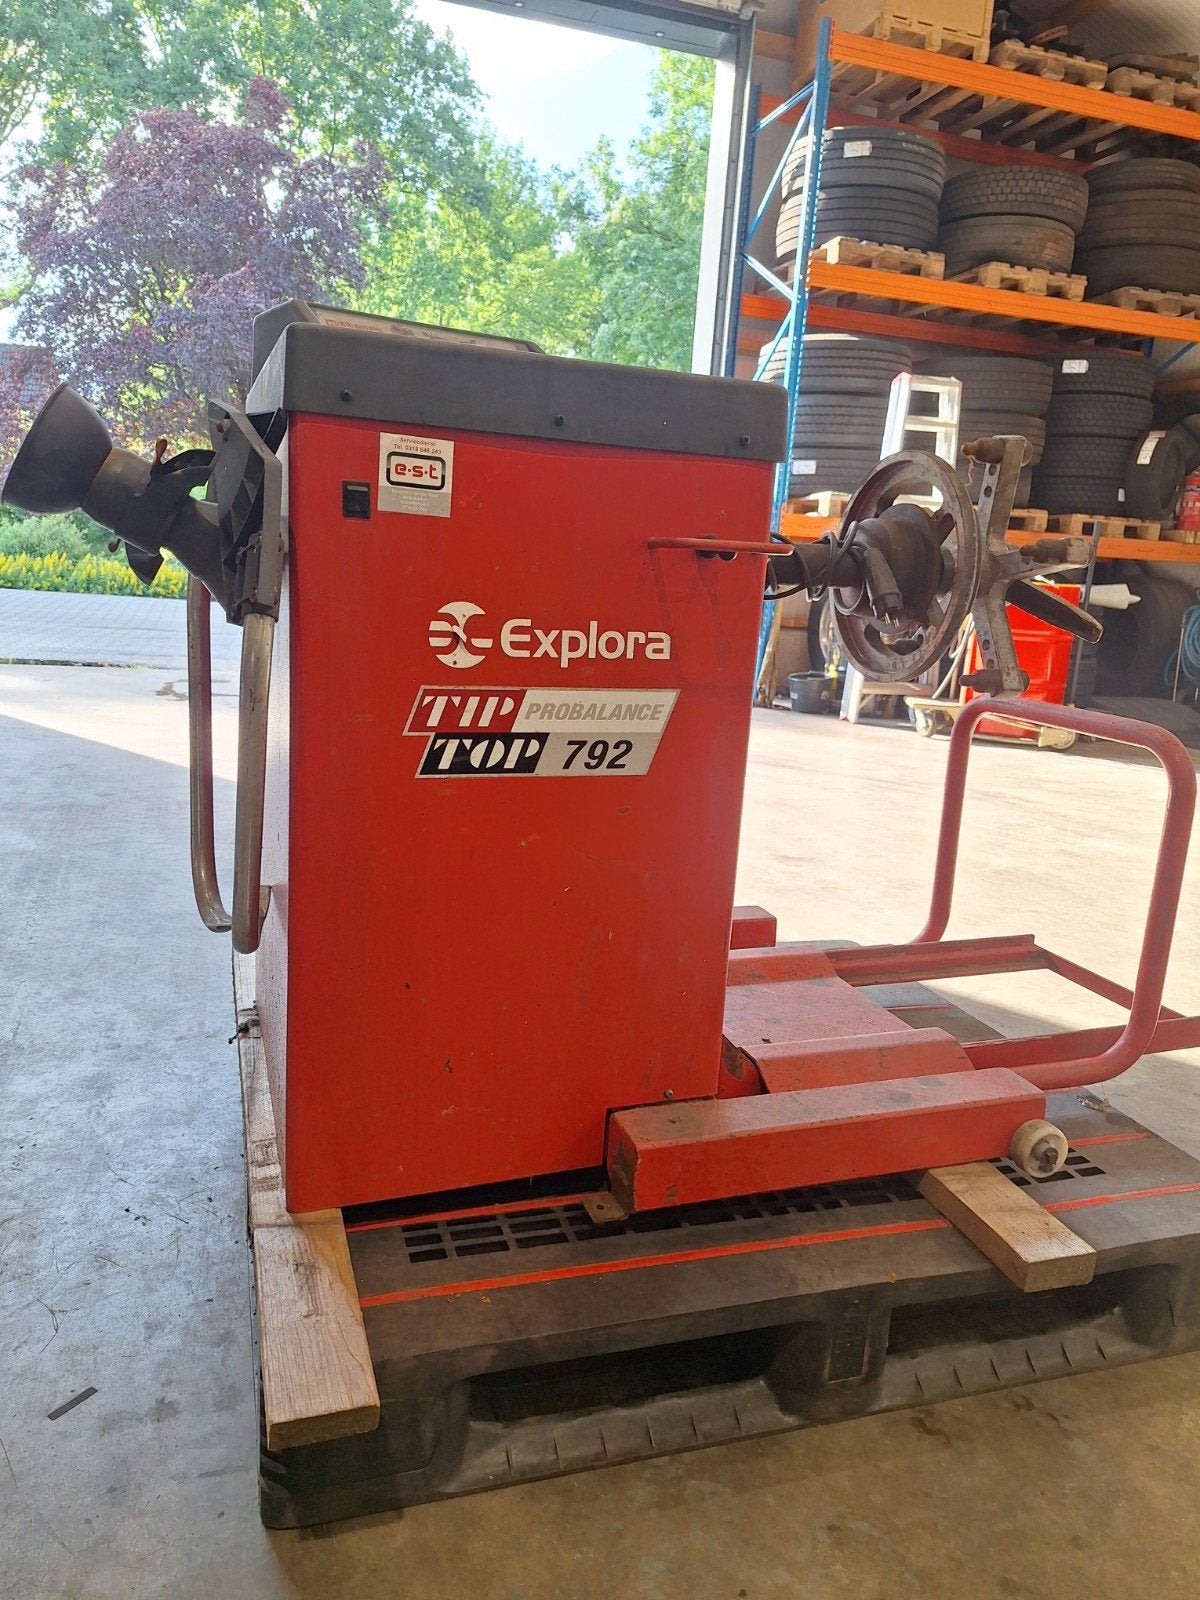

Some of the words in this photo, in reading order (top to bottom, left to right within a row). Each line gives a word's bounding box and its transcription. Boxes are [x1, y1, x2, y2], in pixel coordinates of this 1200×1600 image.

[400, 437, 437, 446] Servicedienst
[500, 618, 671, 668] Explora
[421, 695, 515, 727] TIP
[524, 702, 665, 721] PROBALANCE
[433, 738, 541, 769] TOP
[562, 739, 633, 770] 792
